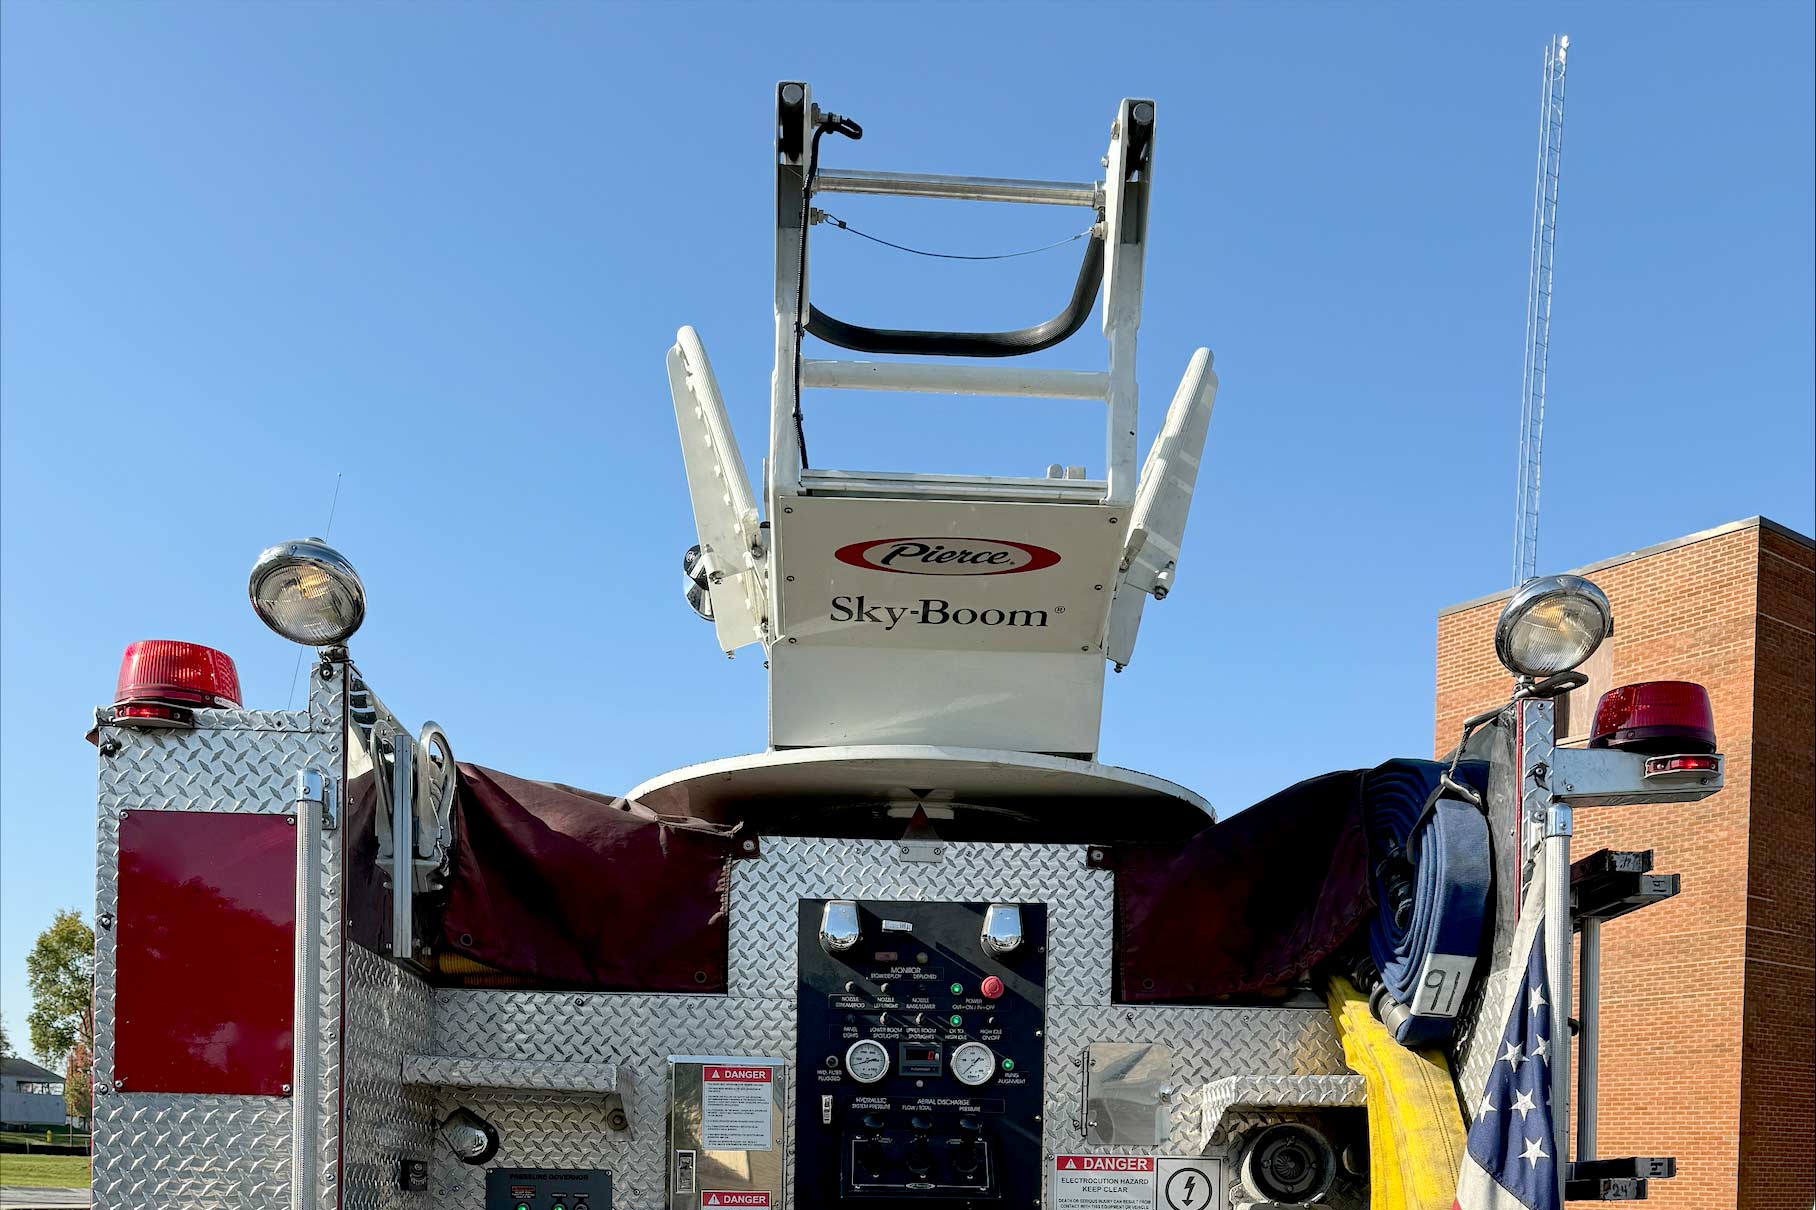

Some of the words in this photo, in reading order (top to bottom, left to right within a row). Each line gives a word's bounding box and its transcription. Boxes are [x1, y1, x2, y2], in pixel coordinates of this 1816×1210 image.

[880, 542, 1011, 566] Pierce
[829, 595, 1049, 631] Sky-Boom
[890, 966, 921, 974] MONITOR
[1424, 968, 1461, 1012] 91
[724, 1070, 766, 1079] DANGER
[1083, 1157, 1148, 1170] DANGER
[1061, 1177, 1119, 1185] ELECTROCUTION
[723, 1195, 766, 1204] DANGER
